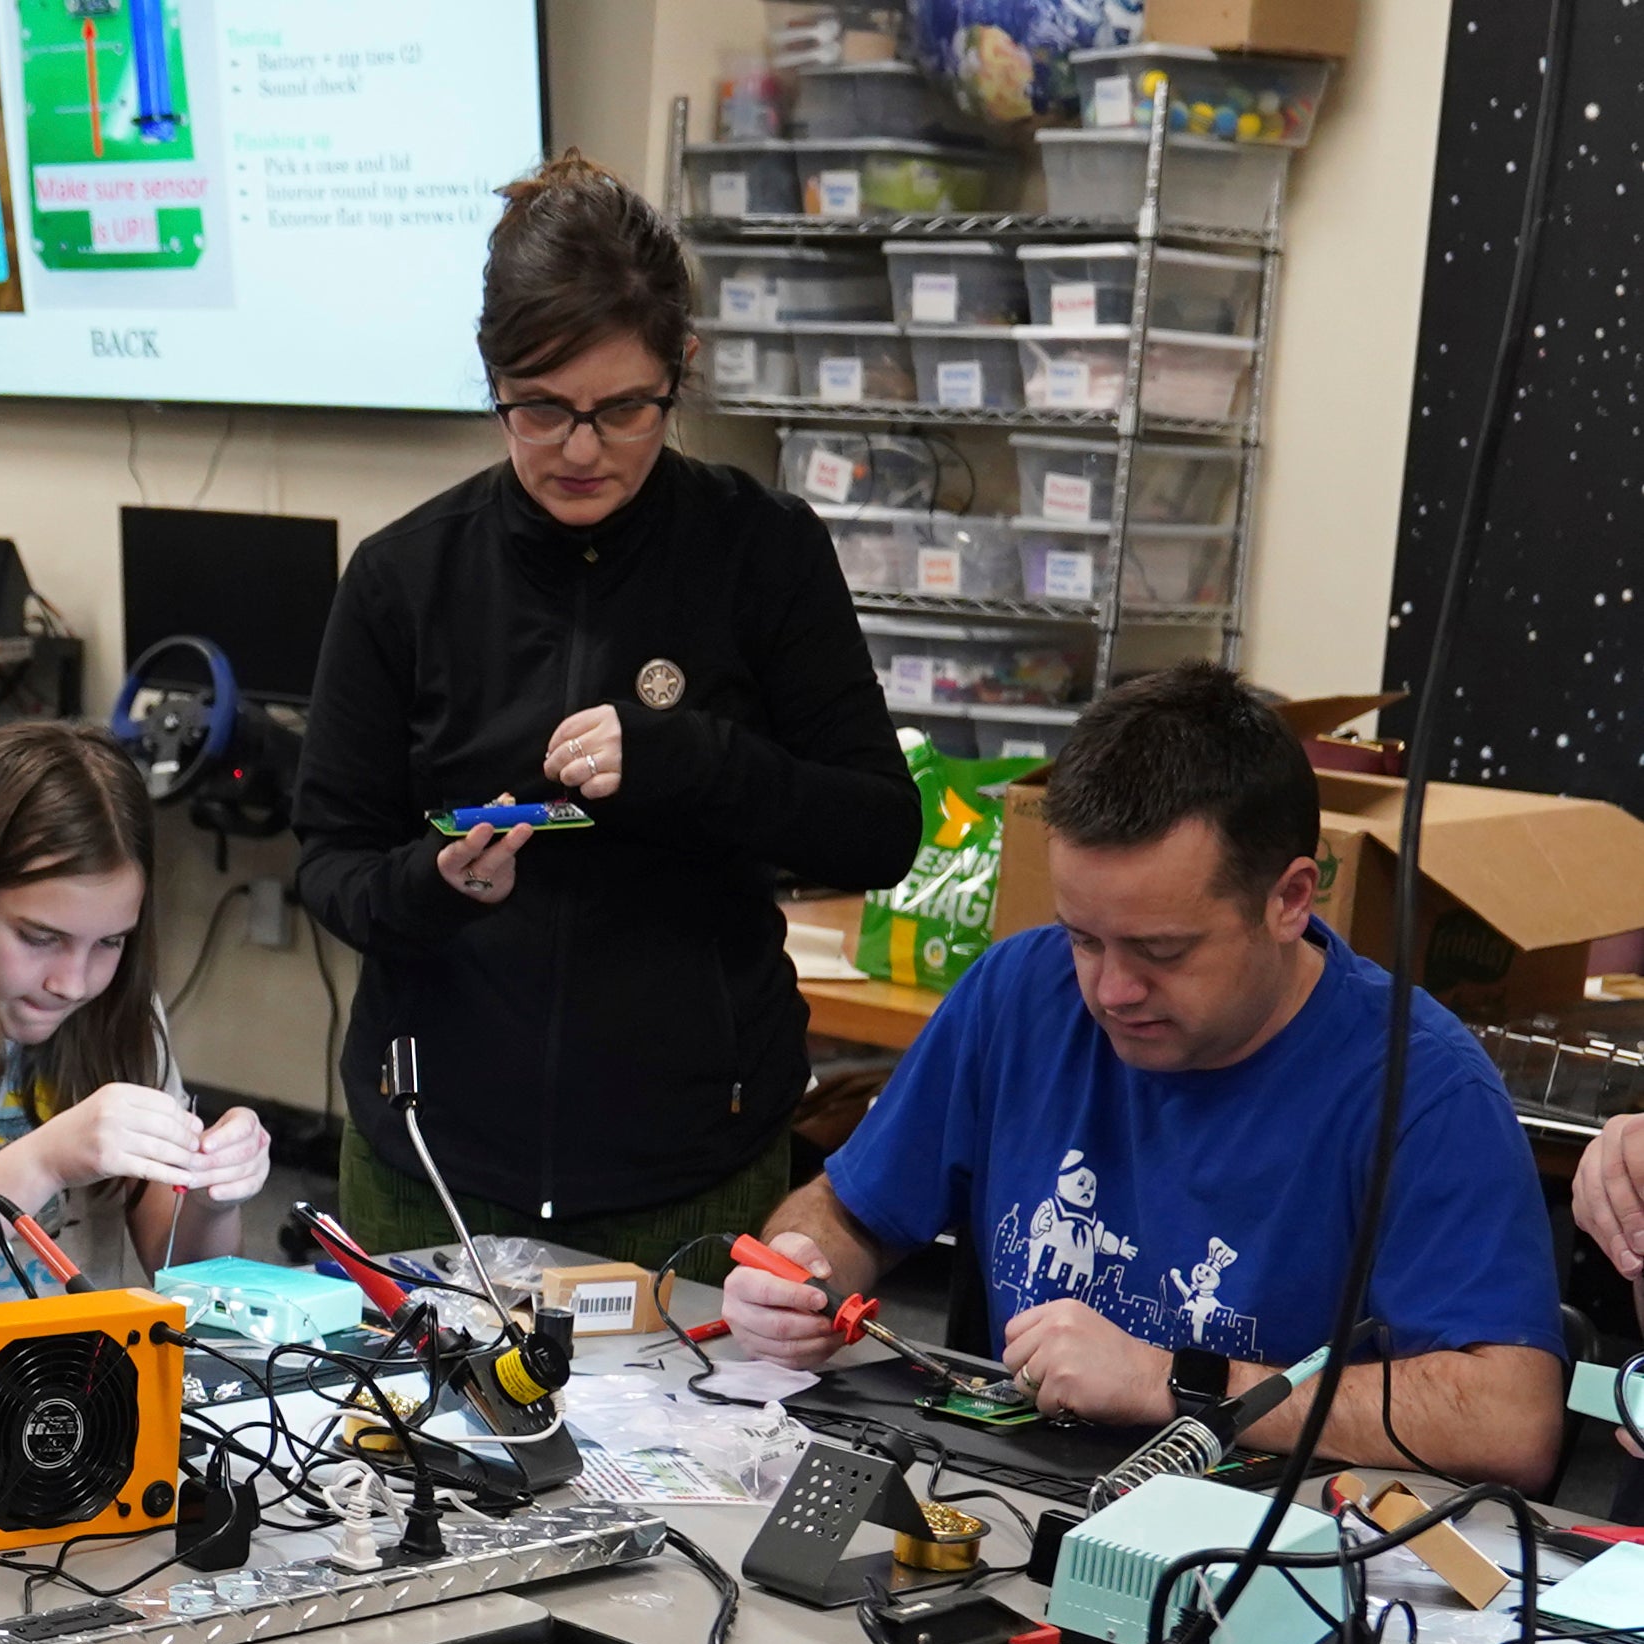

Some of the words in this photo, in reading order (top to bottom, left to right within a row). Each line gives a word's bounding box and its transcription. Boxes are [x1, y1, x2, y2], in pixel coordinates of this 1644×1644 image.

[227, 29, 282, 47] Testing
[257, 52, 315, 72] Battery
[258, 77, 308, 98] Sound
[233, 132, 307, 152] Finishing
[264, 156, 296, 175] Pick
[316, 160, 349, 174] case
[354, 155, 385, 173] and
[390, 153, 412, 172] lid
[36, 177, 87, 201] Make
[95, 179, 134, 200] sure
[142, 176, 209, 200] sensor
[265, 183, 325, 201] Interior
[330, 181, 378, 200] round
[382, 184, 408, 203] top
[414, 181, 469, 197] screws
[268, 208, 330, 229] Exterior
[338, 207, 362, 226] flat
[368, 208, 394, 227] top
[398, 208, 454, 225] screws
[93, 220, 108, 244] is
[90, 328, 160, 358] BACK
